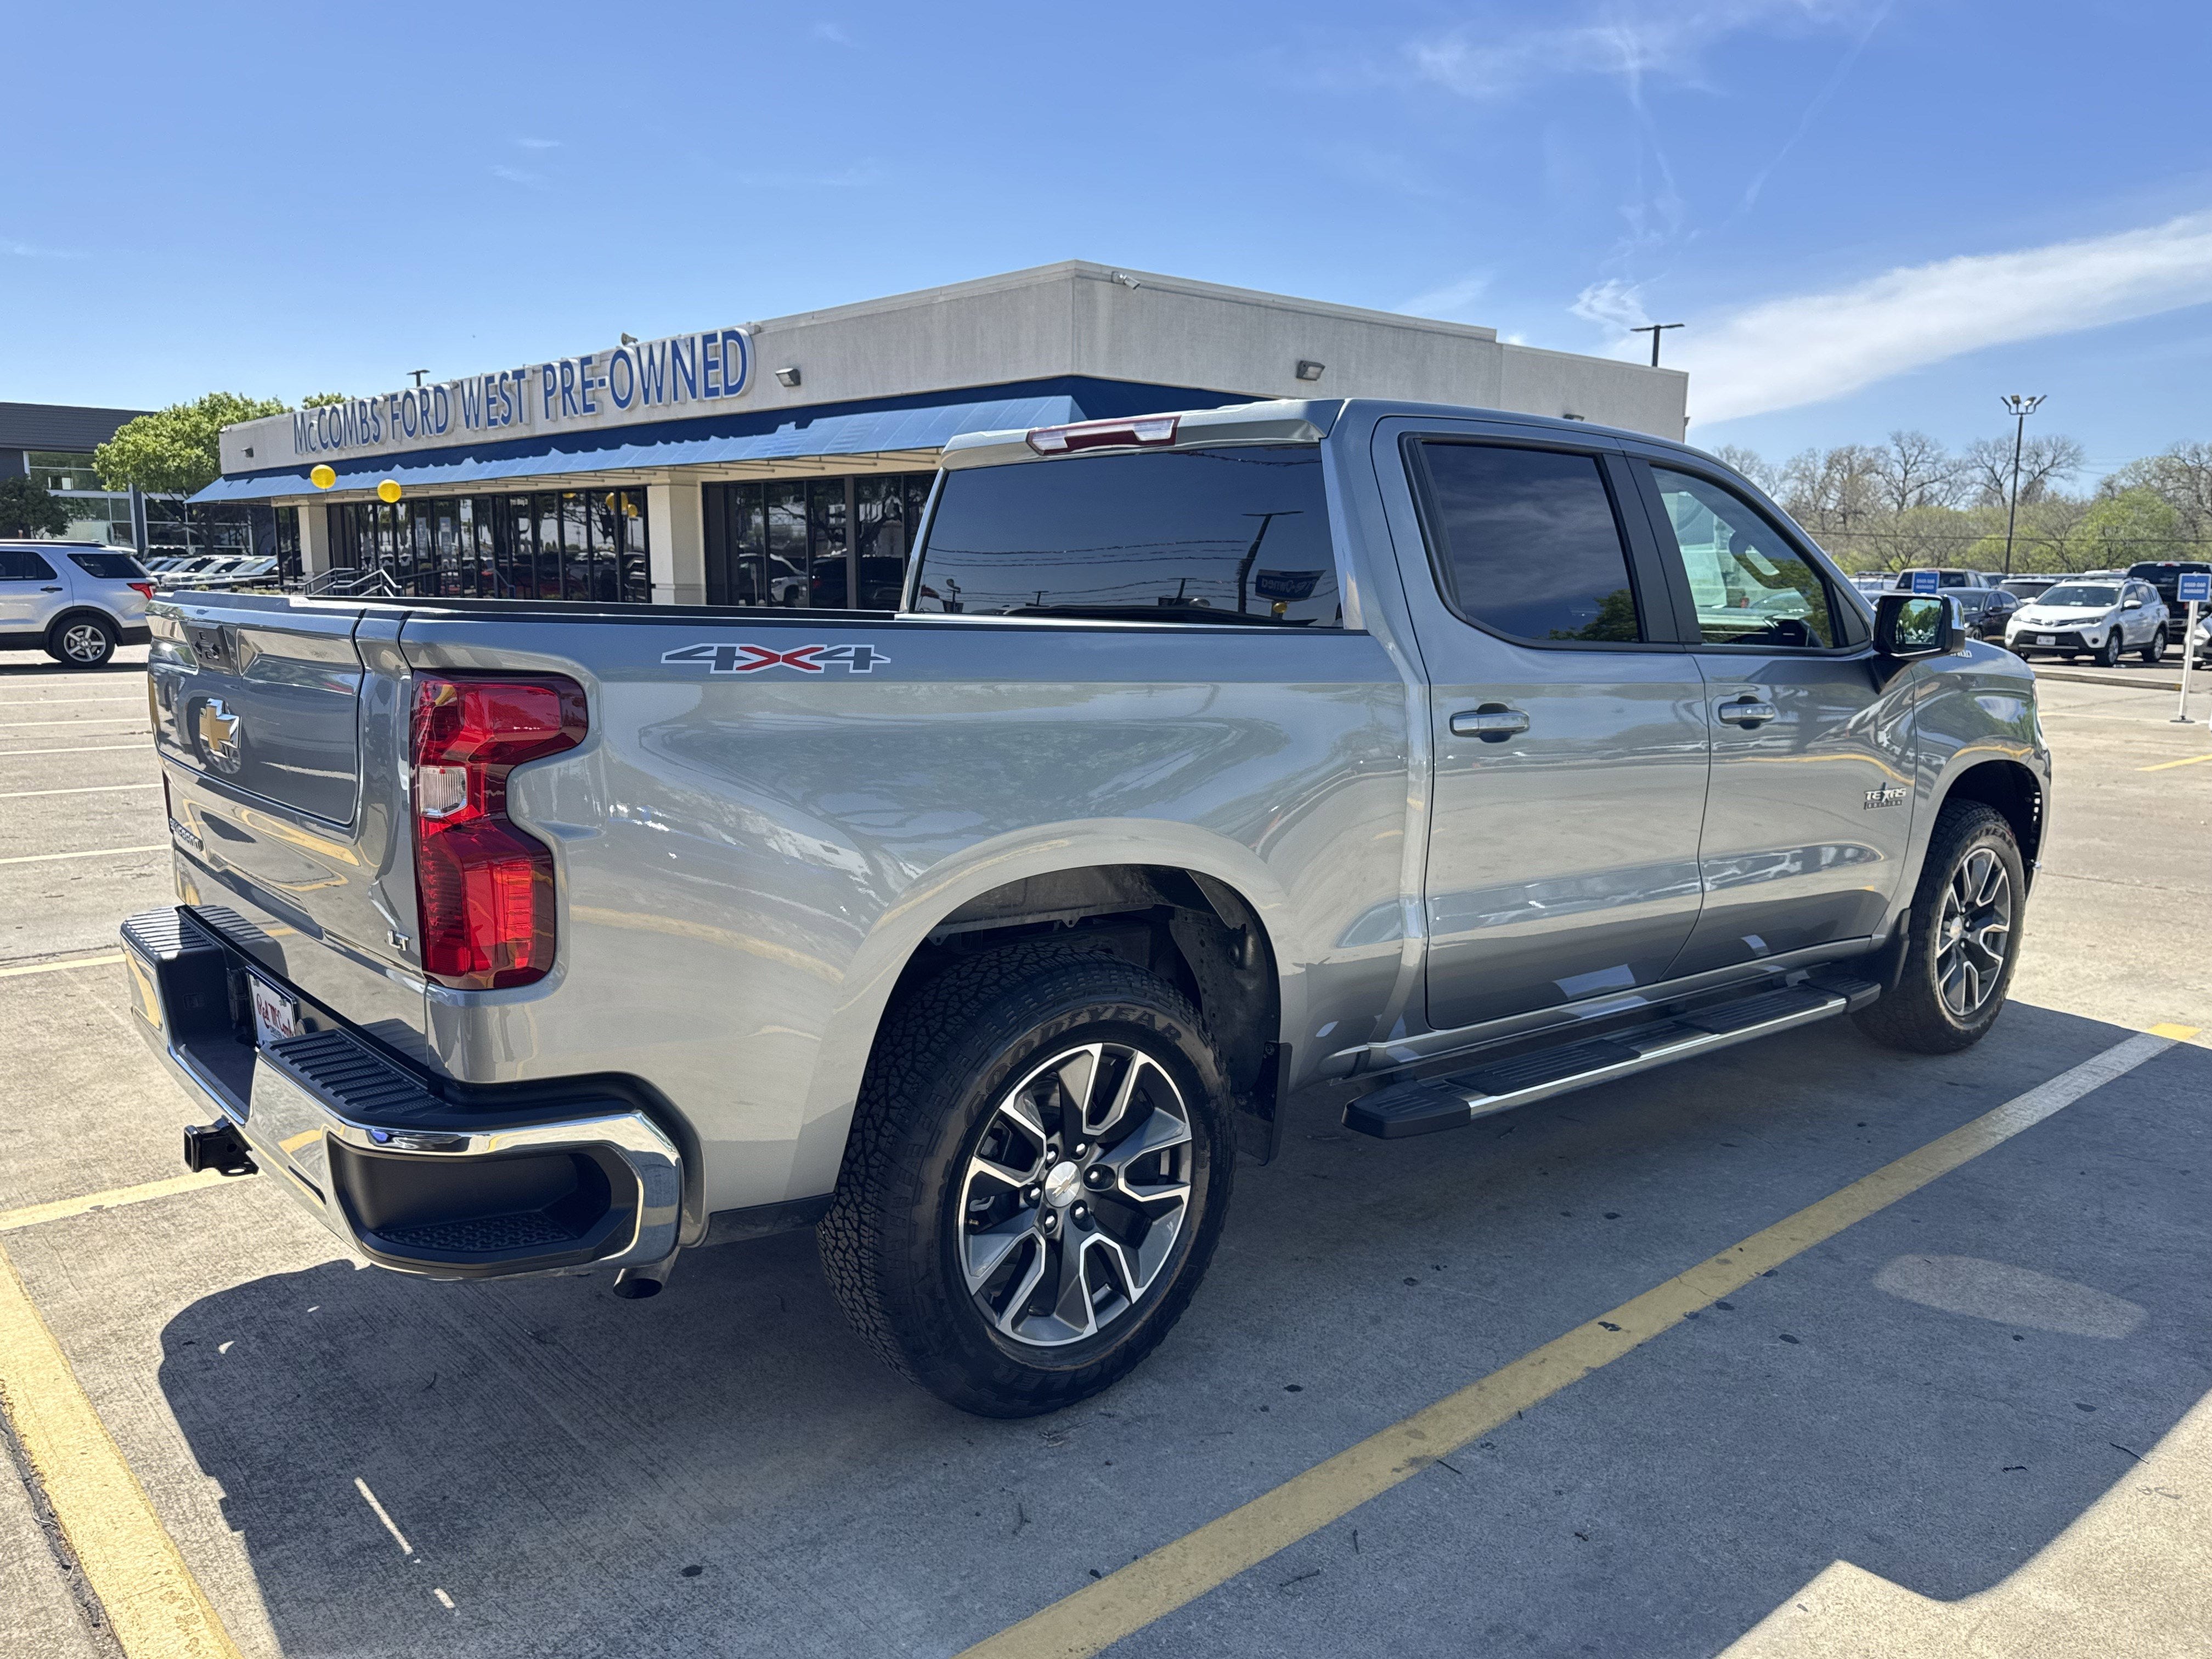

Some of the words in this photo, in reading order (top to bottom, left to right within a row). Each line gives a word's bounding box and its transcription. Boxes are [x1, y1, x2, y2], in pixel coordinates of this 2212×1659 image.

[391, 383, 449, 440] FORD
[459, 369, 526, 431] WEST
[543, 329, 751, 421] PRE-OWNED
[1864, 786, 1906, 803] TEXAS
[387, 930, 410, 951] LT
[963, 1003, 1183, 1129] GOODYEAR
